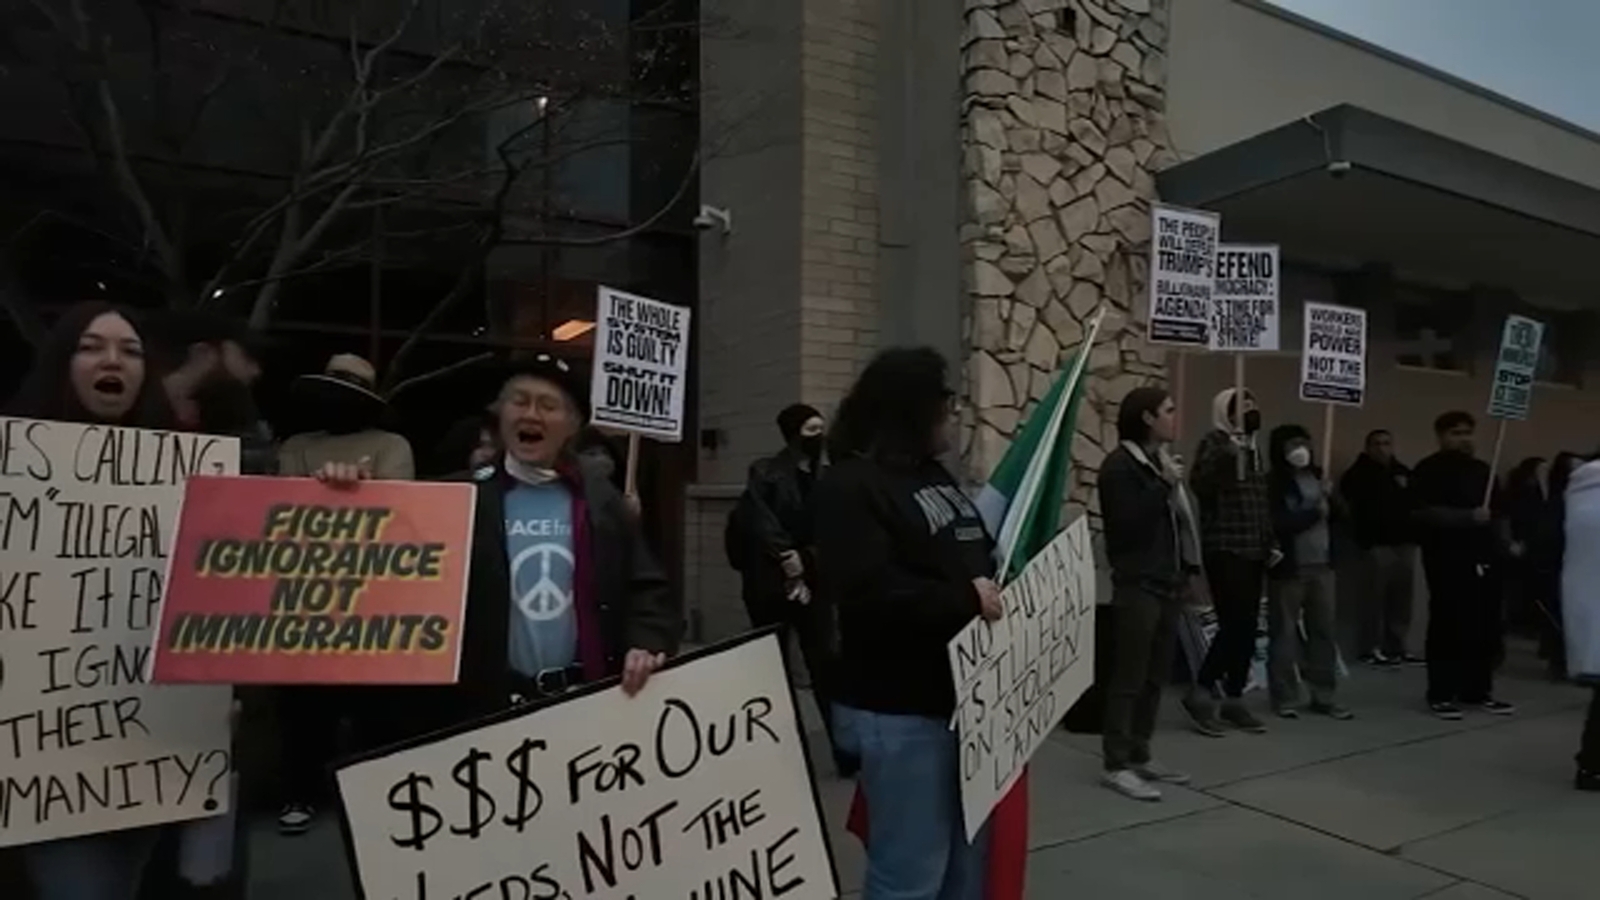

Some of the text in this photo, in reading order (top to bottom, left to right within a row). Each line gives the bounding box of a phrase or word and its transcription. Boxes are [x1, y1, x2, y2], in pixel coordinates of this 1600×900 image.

[606, 317, 681, 344] SYSTEM
[609, 294, 681, 331] THE WHOLE
[606, 329, 679, 368] IS GUILTY
[1309, 331, 1361, 356] POWER
[603, 361, 658, 382] SHUT
[1308, 355, 1361, 376] NOT THE
[606, 375, 673, 416] DOWN!
[0, 419, 225, 486] ES CALLING
[264, 504, 392, 541] FIGHT
[195, 540, 446, 581] IGNORANCE
[271, 578, 368, 616] NOT
[169, 614, 451, 656] IMMIGRANTS
[957, 616, 993, 681] NO
[0, 696, 151, 758] THEIR
[0, 749, 230, 828] MANITY?
[387, 698, 780, 850] $$$ FOR OUR
[576, 802, 678, 893] NOT
[682, 789, 766, 850] THE
